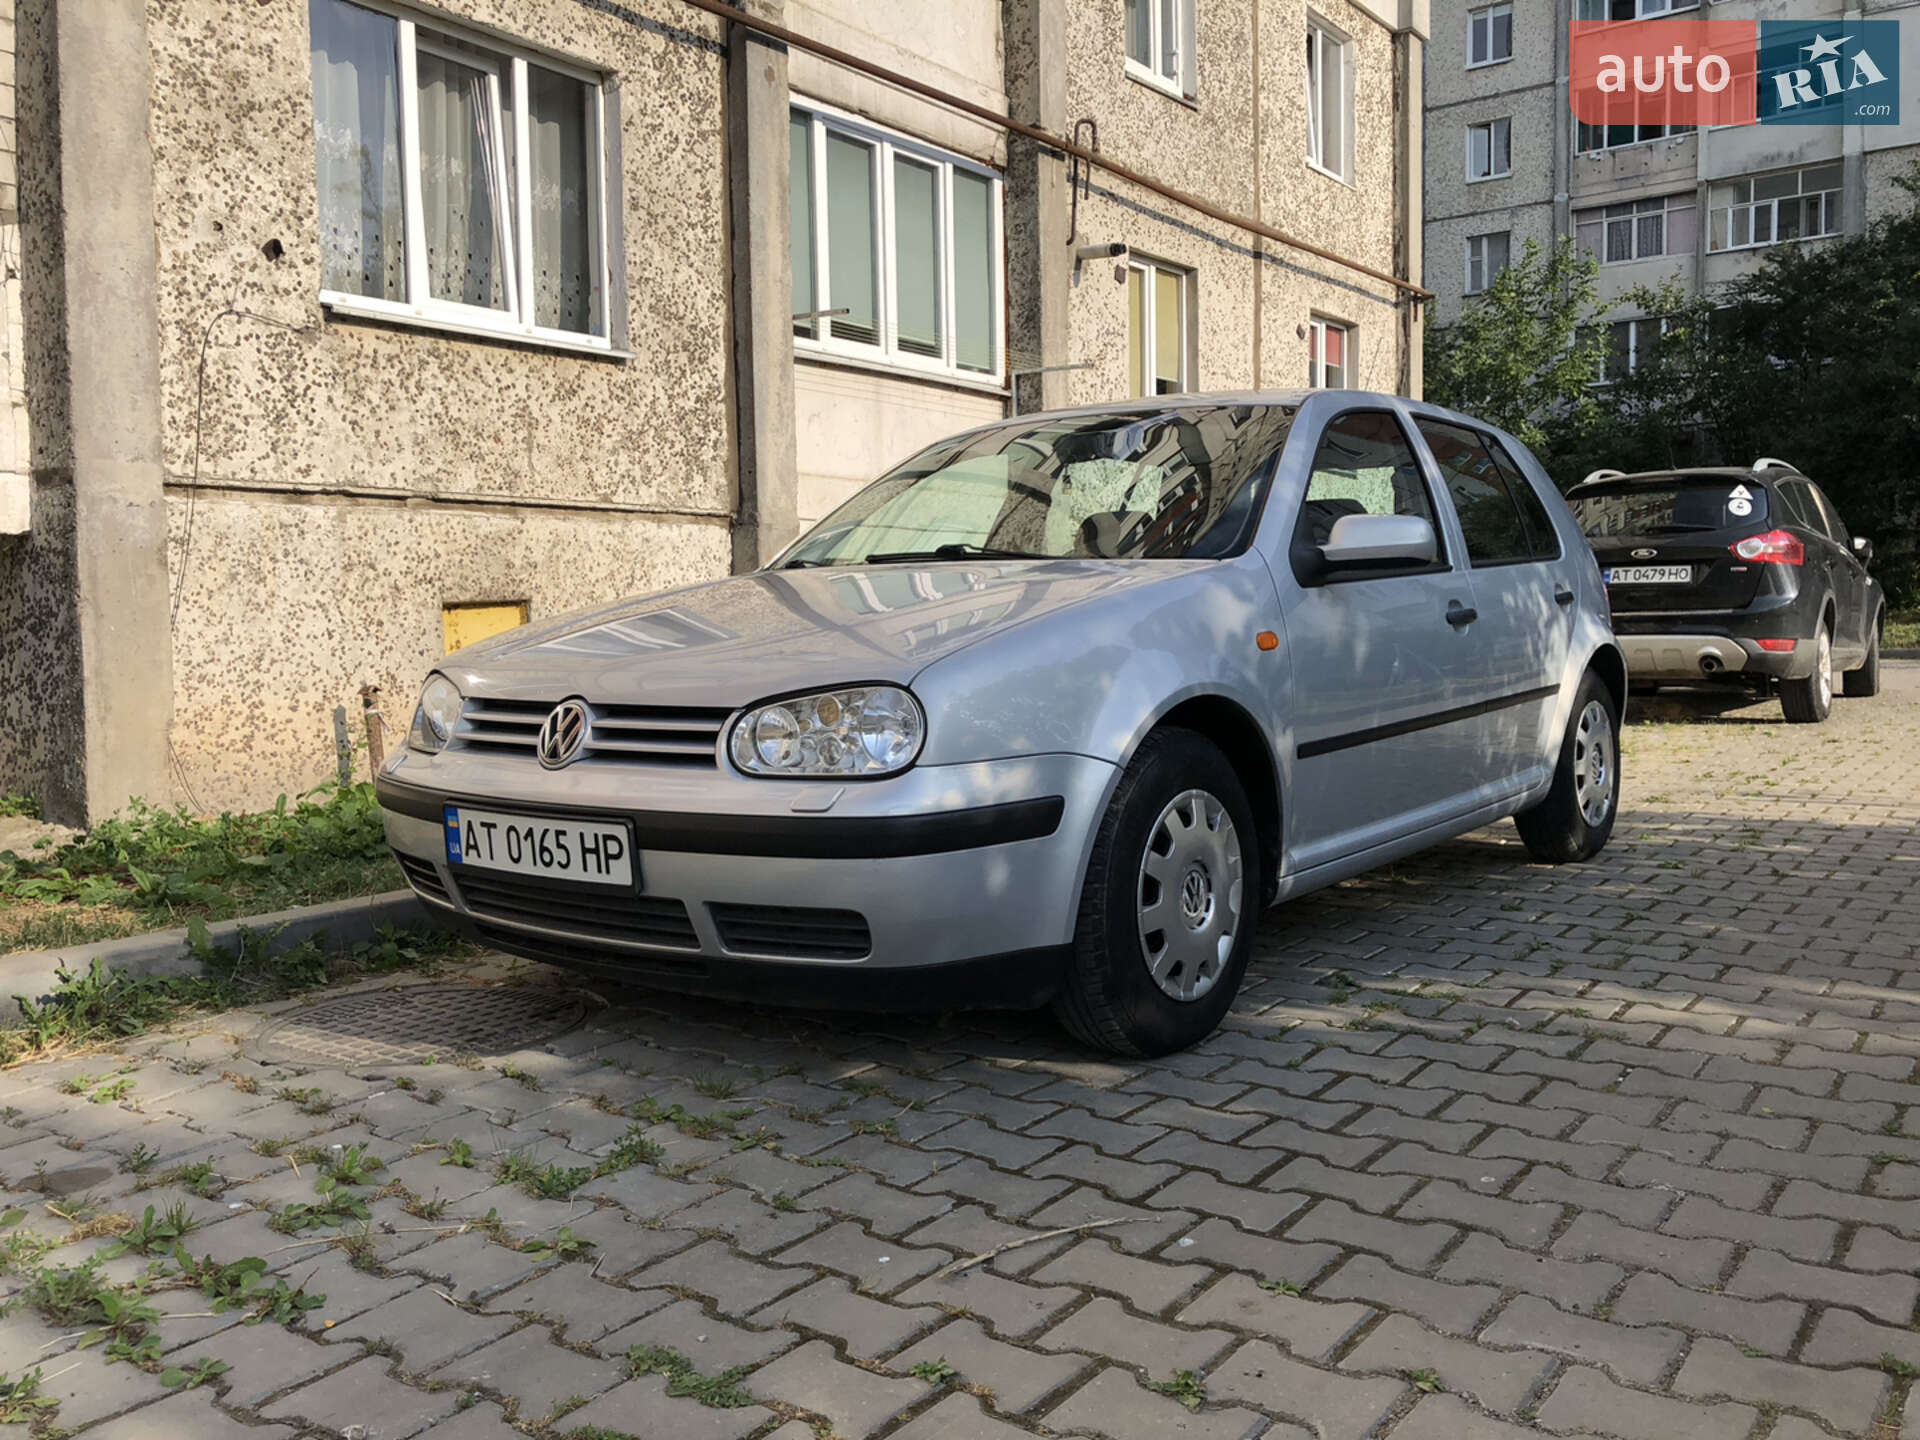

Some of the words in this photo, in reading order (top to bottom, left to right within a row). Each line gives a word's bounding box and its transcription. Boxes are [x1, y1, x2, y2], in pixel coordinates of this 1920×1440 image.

[1611, 569, 1632, 581] AT
[1633, 568, 1666, 581] 0479
[1668, 567, 1689, 580] HO
[464, 819, 498, 861] AT
[506, 824, 571, 869] 0165
[579, 831, 624, 875] HP
